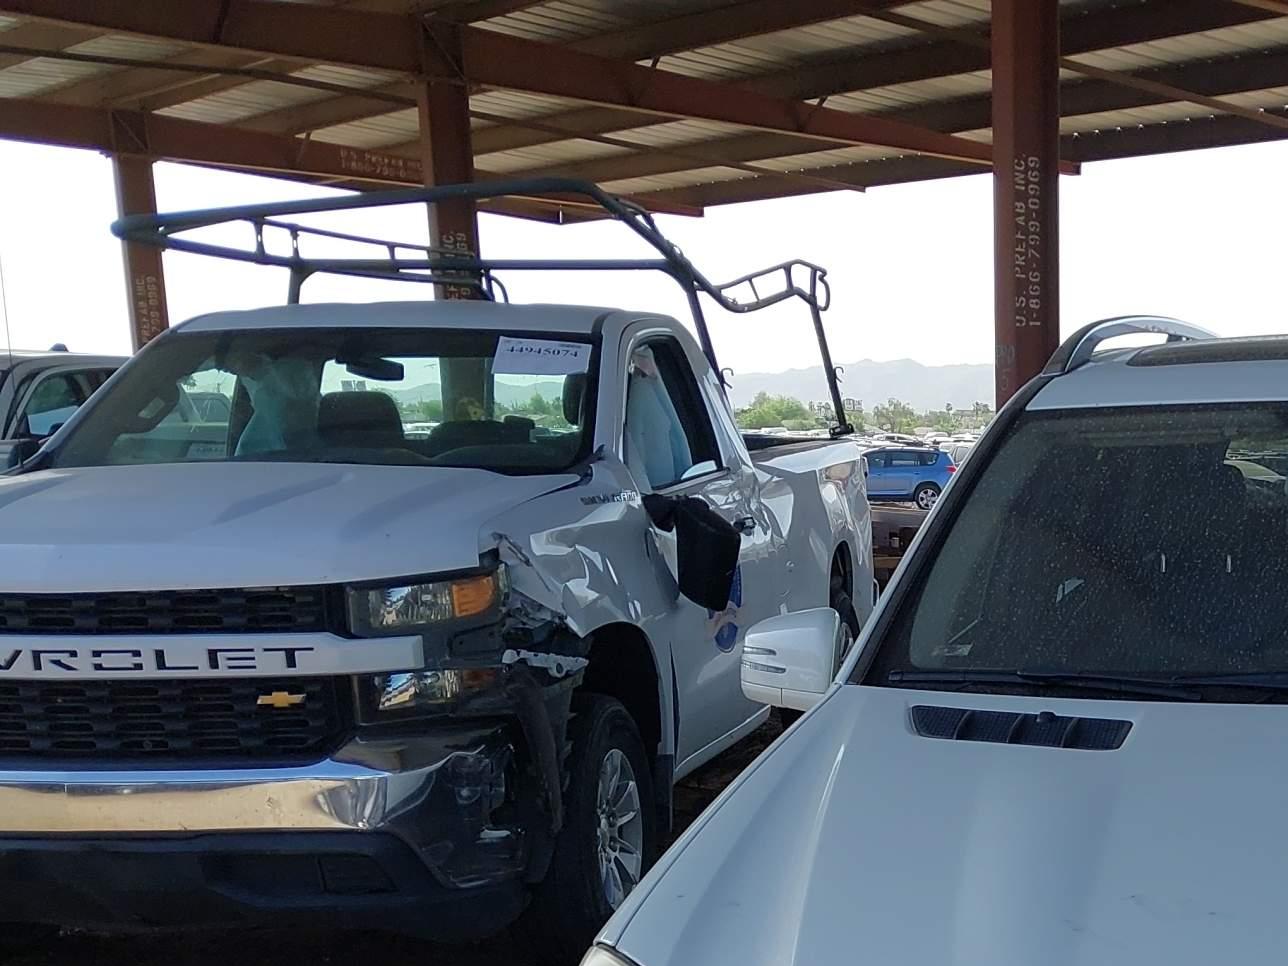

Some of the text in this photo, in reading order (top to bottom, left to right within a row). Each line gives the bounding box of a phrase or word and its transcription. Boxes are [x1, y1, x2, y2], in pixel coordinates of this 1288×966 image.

[1014, 153, 1026, 327] U.S. PREFAB INC.
[1028, 156, 1041, 326] 1-866-799-0969
